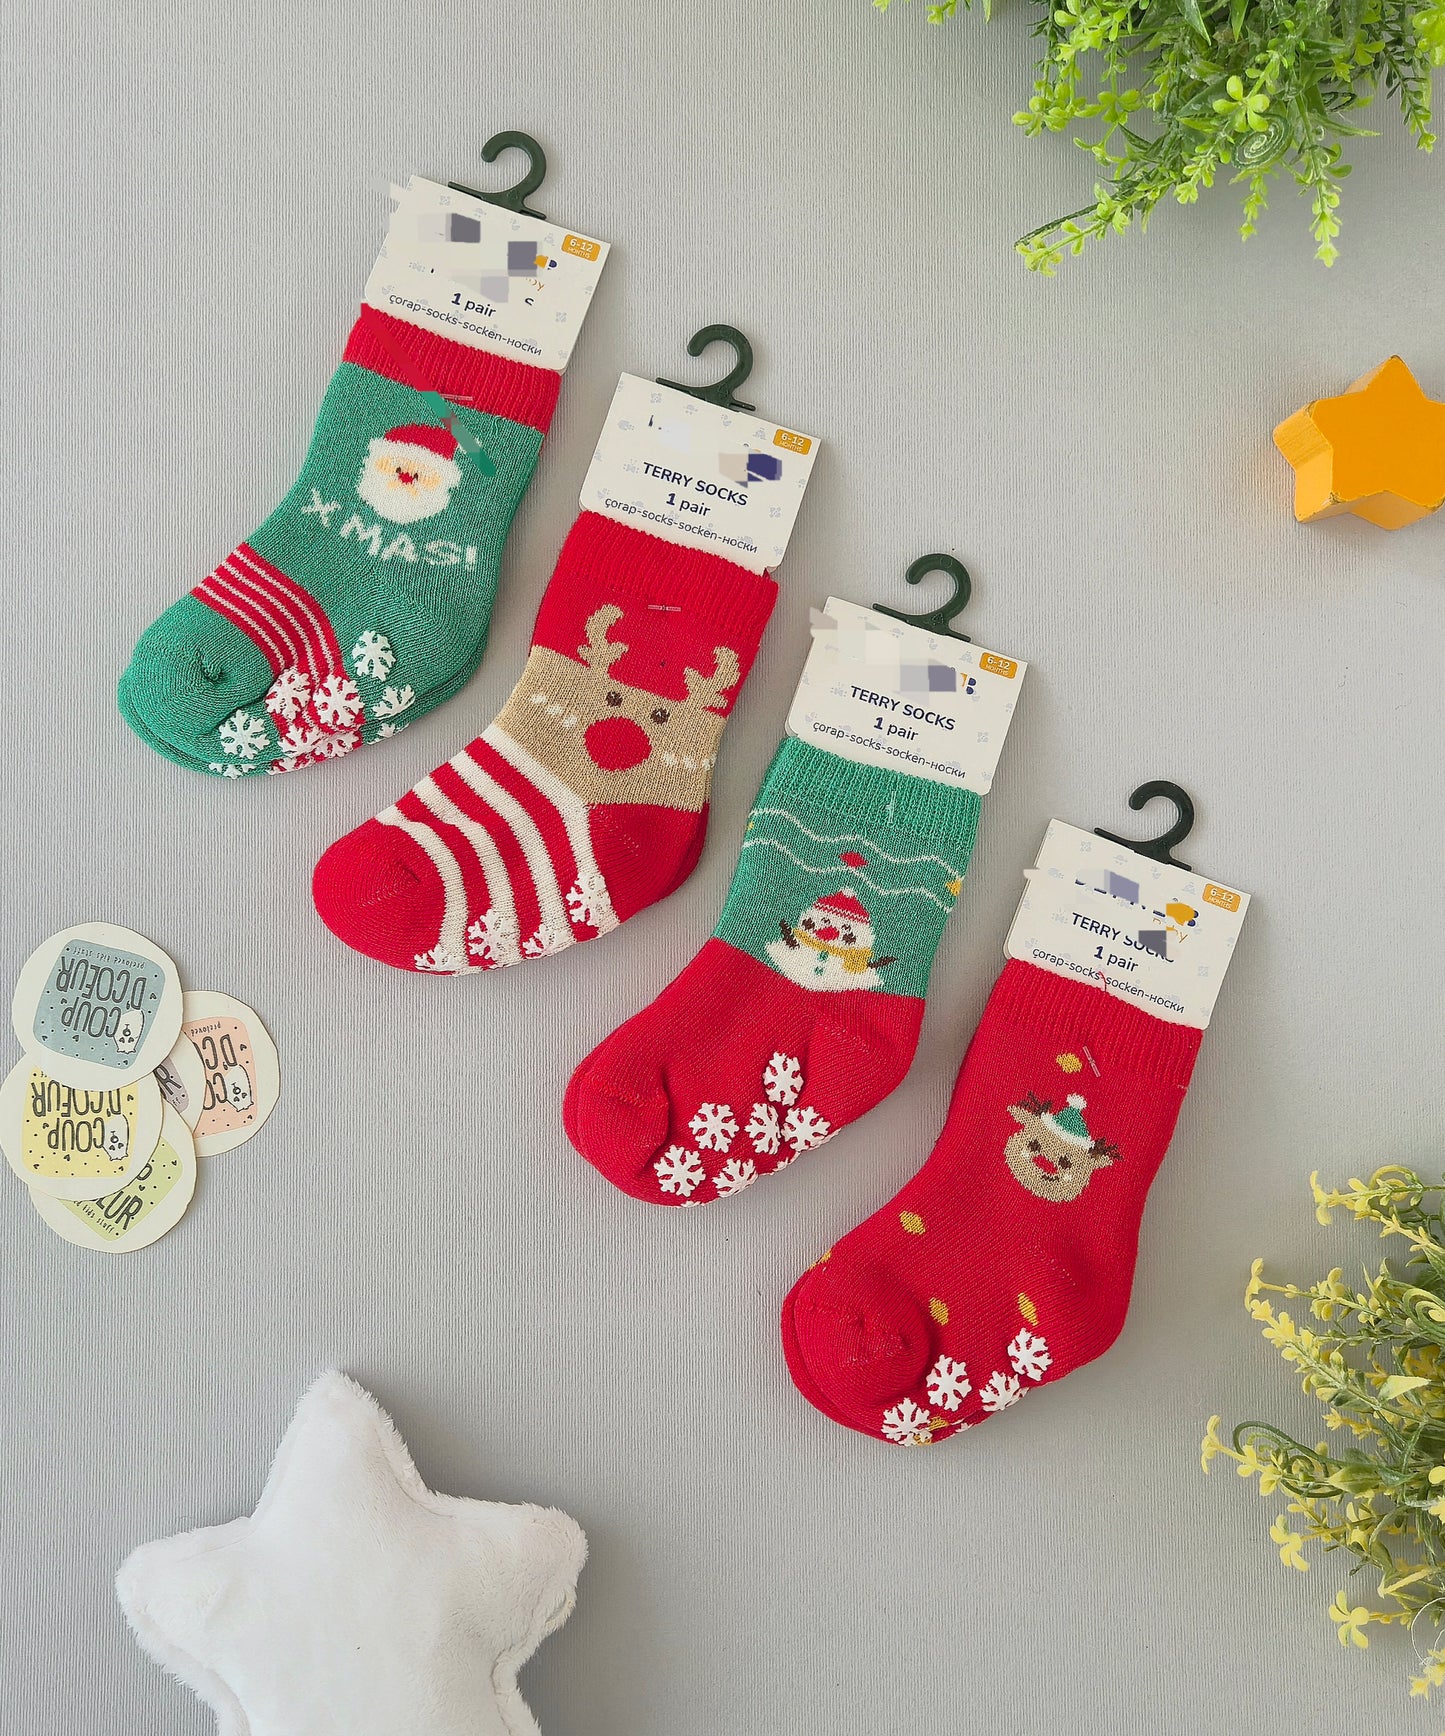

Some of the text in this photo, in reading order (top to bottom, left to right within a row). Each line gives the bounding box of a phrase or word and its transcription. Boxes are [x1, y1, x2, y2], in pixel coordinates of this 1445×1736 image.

[570, 238, 593, 253] 6-12
[451, 292, 497, 318] 1 pair
[782, 433, 804, 446] 6-12
[643, 461, 749, 506] TERRY SOCKS
[665, 492, 711, 517] 1 pair
[987, 656, 1010, 669] 6-12
[850, 685, 956, 731] TERRY SOCKS
[873, 717, 919, 741] 1 pair
[1210, 888, 1234, 903] 6-12
[1072, 912, 1121, 941] TERRY
[1093, 945, 1139, 973] 1 pair
[56, 956, 147, 1010] D'COEUR
[61, 996, 121, 1038] COUP
[47, 1117, 105, 1153] COUP
